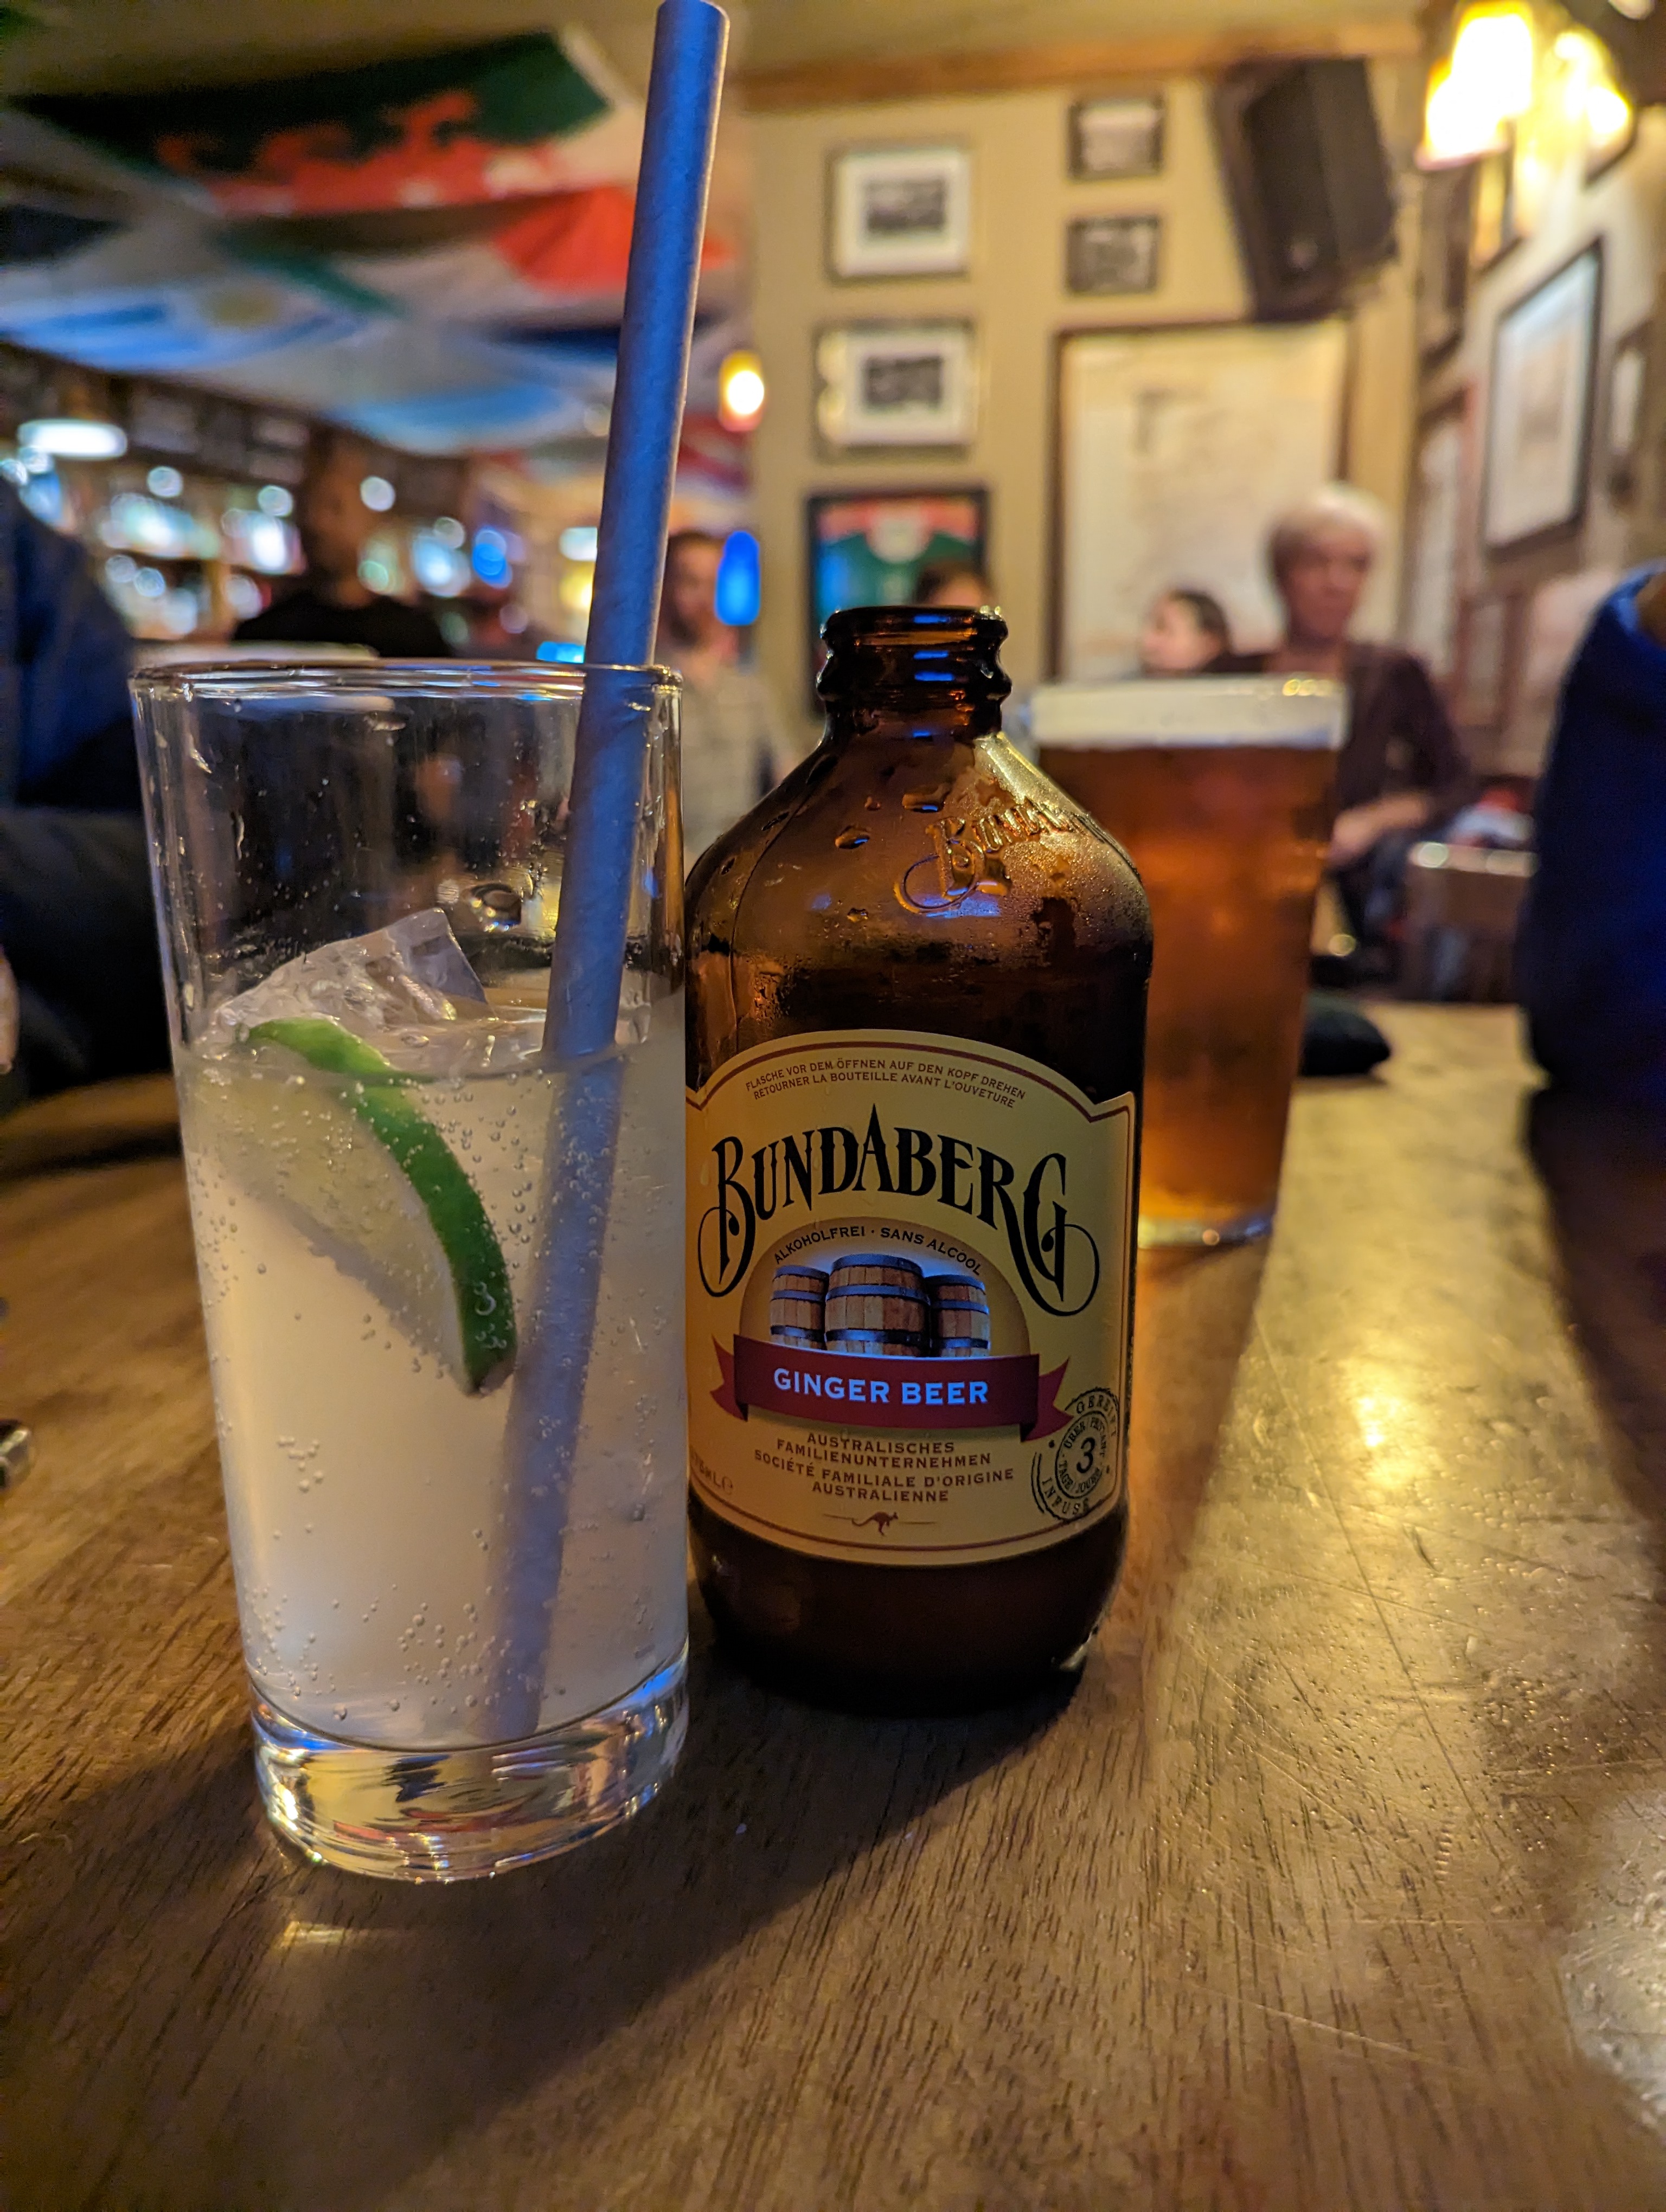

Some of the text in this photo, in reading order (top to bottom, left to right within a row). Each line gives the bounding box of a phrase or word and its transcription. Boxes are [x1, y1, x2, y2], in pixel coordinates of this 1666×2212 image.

[746, 1058, 1026, 1099] FLASCHE VOR DEM ÖFFNEN AUF DEN KOPF DREHEN
[754, 1072, 1016, 1108] RETOURNER LA BOUTEILLE AVANT L'OUVETURE
[697, 1103, 1100, 1316] BUNDABERG
[774, 1226, 986, 1276] ALKOHOLFREI SANS ALCOOL
[774, 1368, 989, 1405] GINGER BEER
[777, 1438, 991, 1469] FAMILIENUNTERNEHMEN
[807, 1432, 956, 1455] AUSTRALISCHES
[1076, 1437, 1095, 1474] 3
[754, 1449, 1014, 1488] SOCIÉTÉ FAMILIALE D'ORIGINE
[811, 1481, 949, 1502] AUSTRALIENNE
